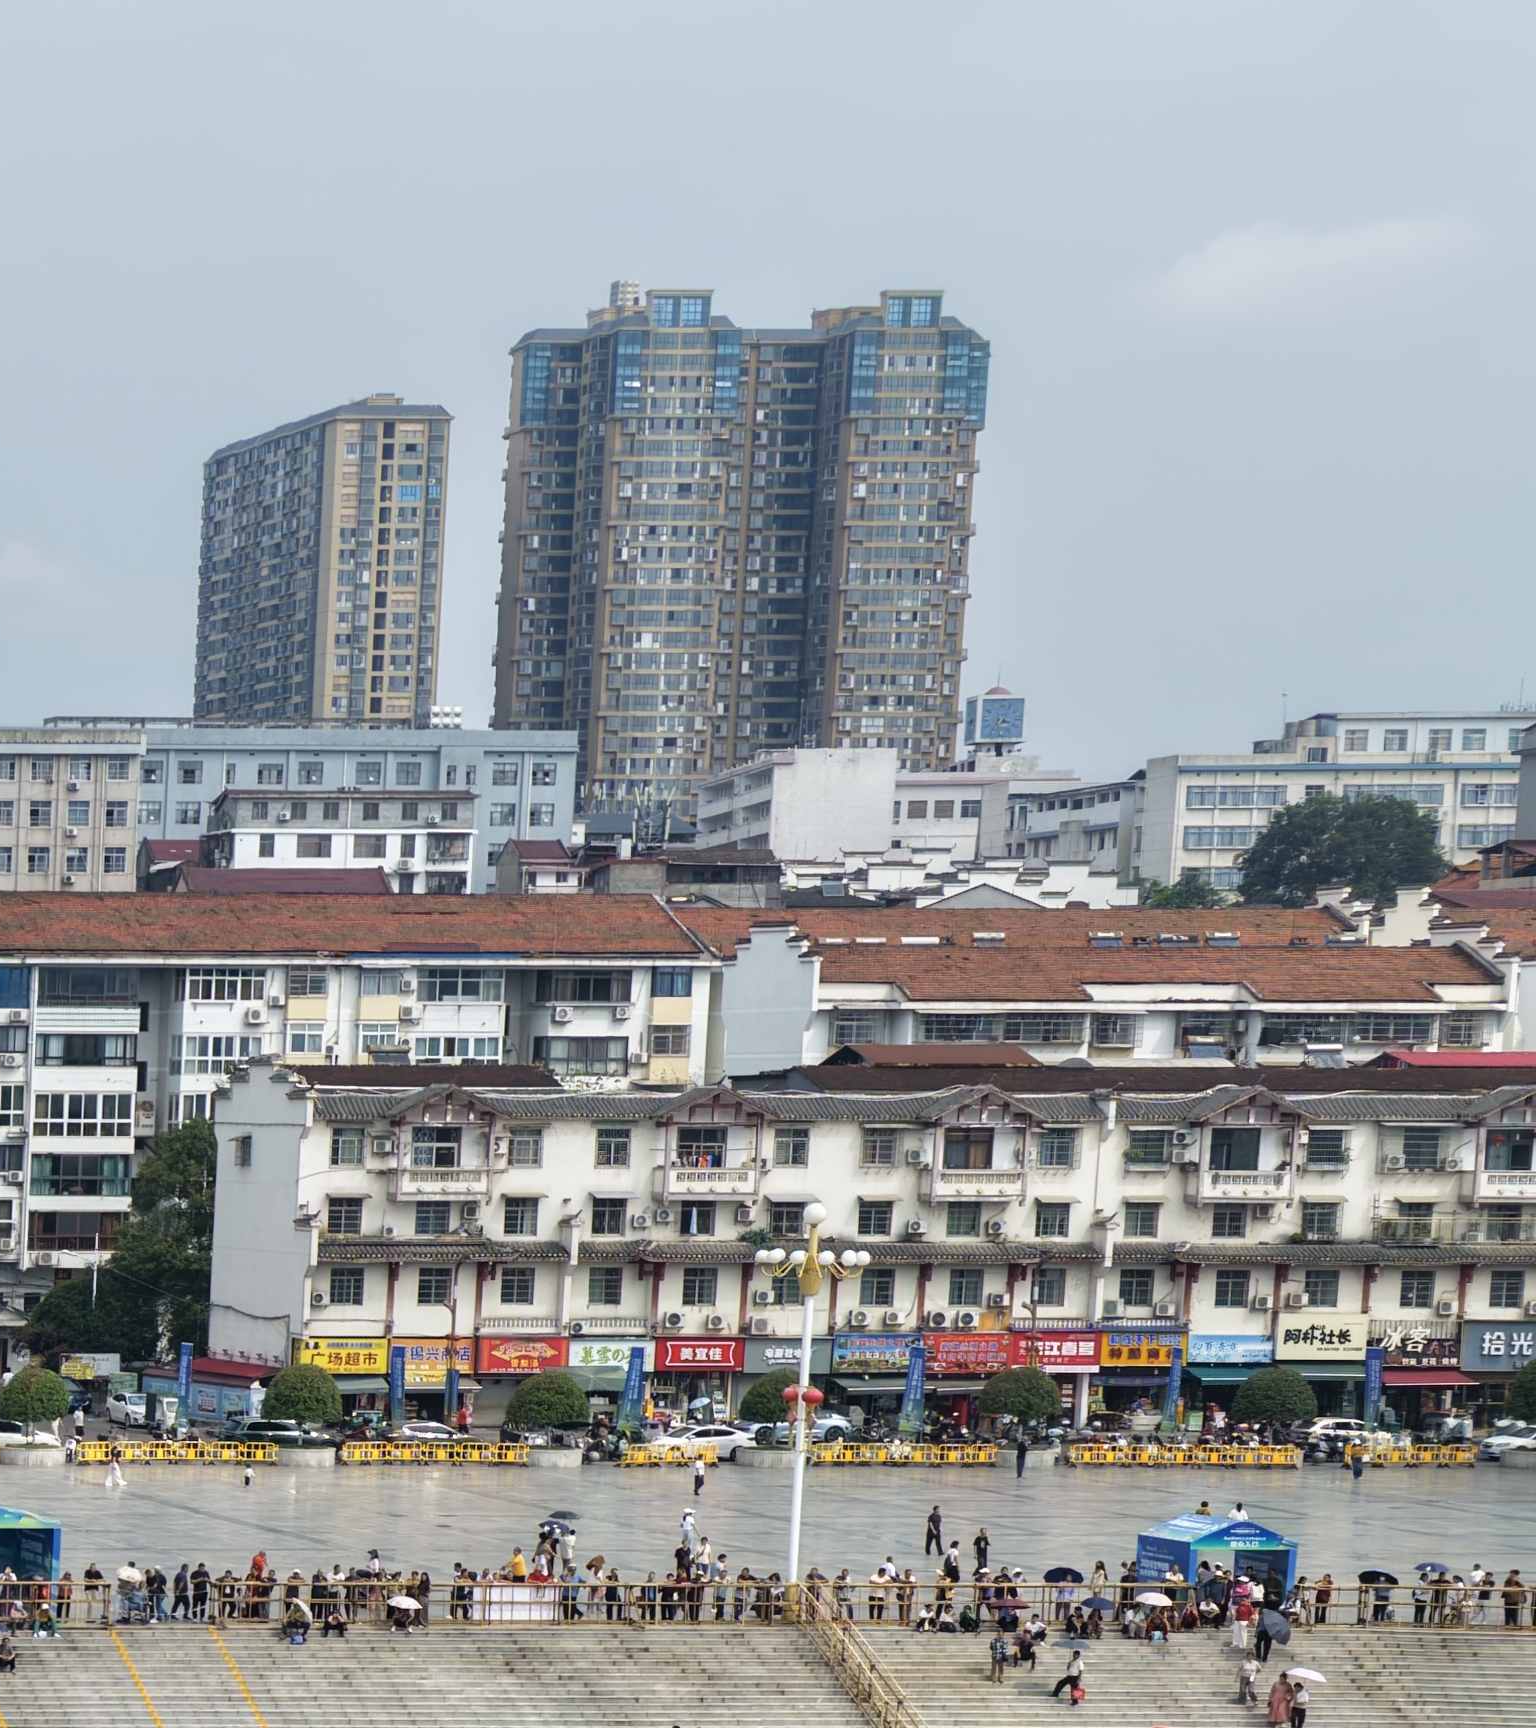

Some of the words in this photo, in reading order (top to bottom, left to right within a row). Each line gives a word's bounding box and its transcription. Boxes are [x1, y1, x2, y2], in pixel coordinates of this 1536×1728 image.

[1380, 1326, 1431, 1353] 冰客
[1482, 1331, 1534, 1356] 拾光
[311, 1352, 379, 1367] 广场超市
[680, 1348, 723, 1360] 美宜佳
